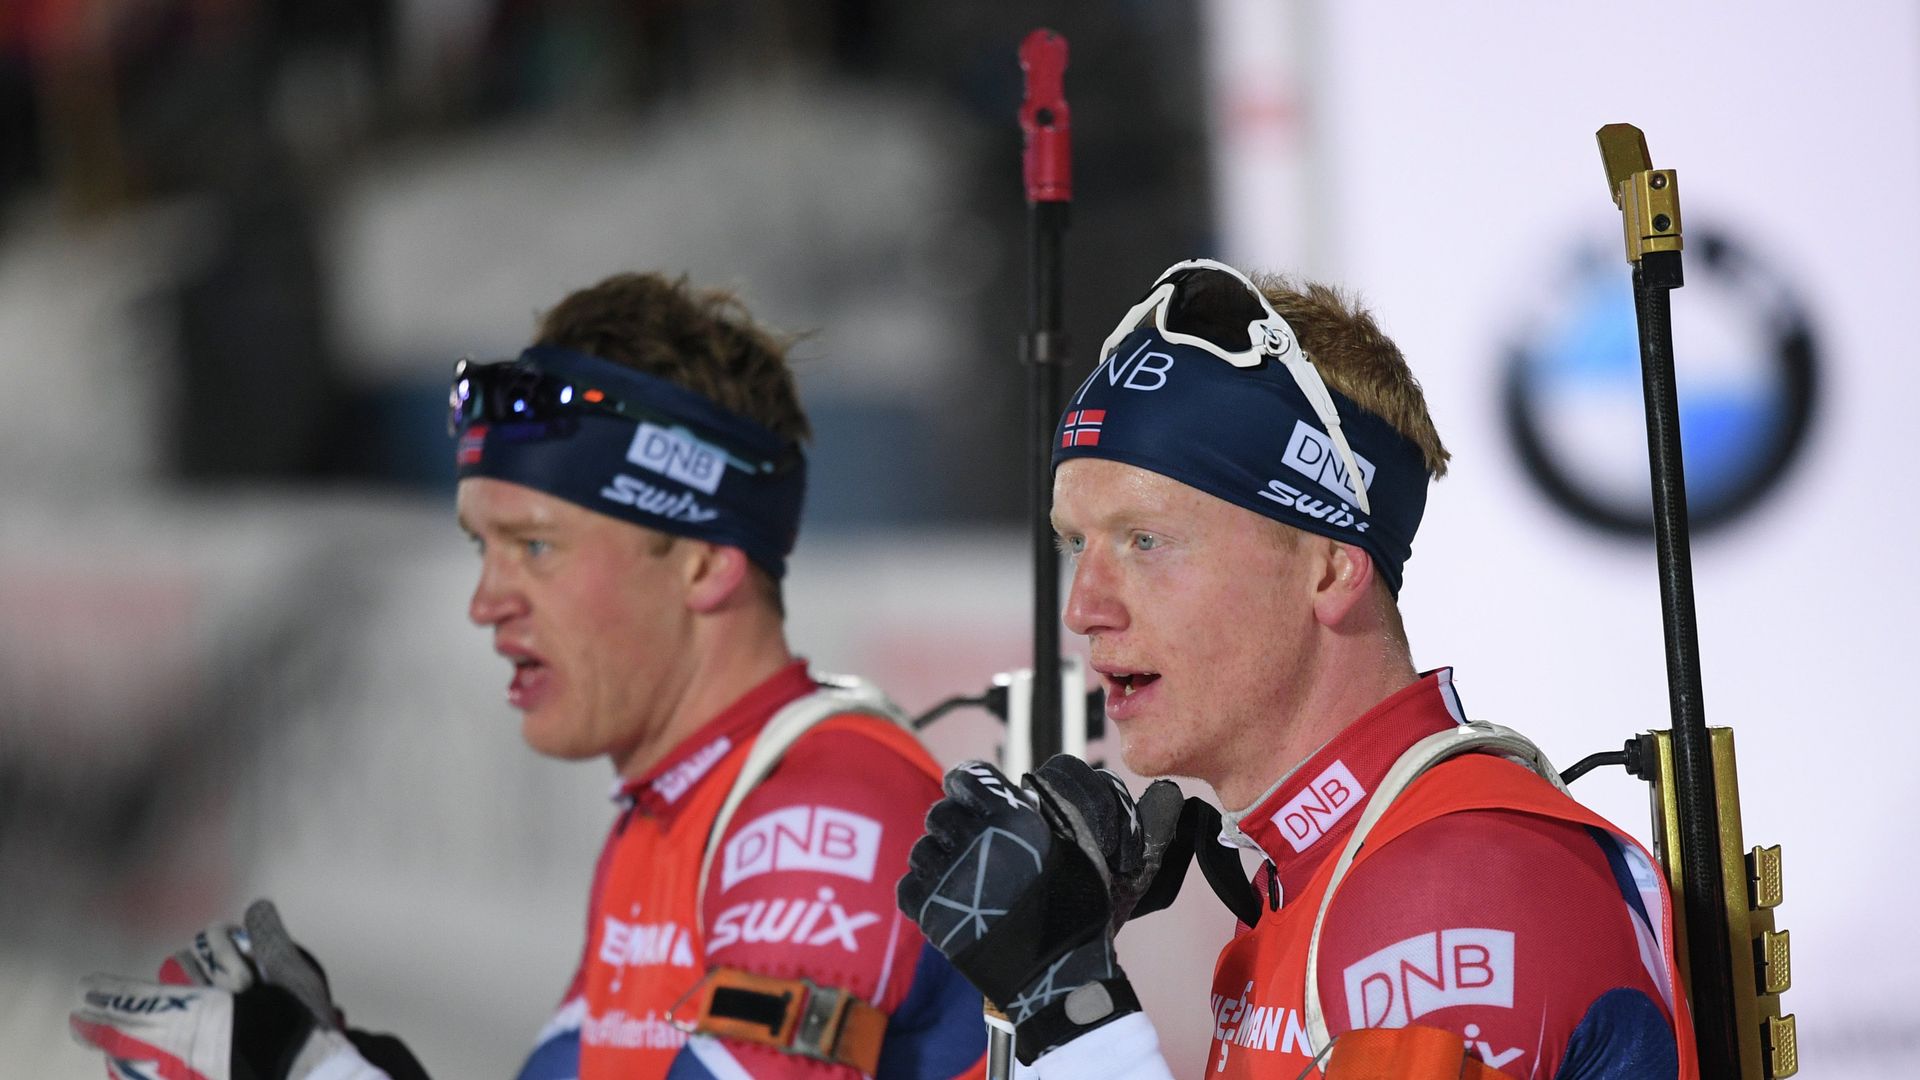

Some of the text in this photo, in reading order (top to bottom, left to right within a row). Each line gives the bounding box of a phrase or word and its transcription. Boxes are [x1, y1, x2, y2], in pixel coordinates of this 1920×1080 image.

[1076, 339, 1174, 404] NB
[644, 433, 716, 480] DNB
[735, 806, 856, 872] DNB
[1285, 779, 1350, 840] DNB
[1361, 931, 1494, 1028] DNB
